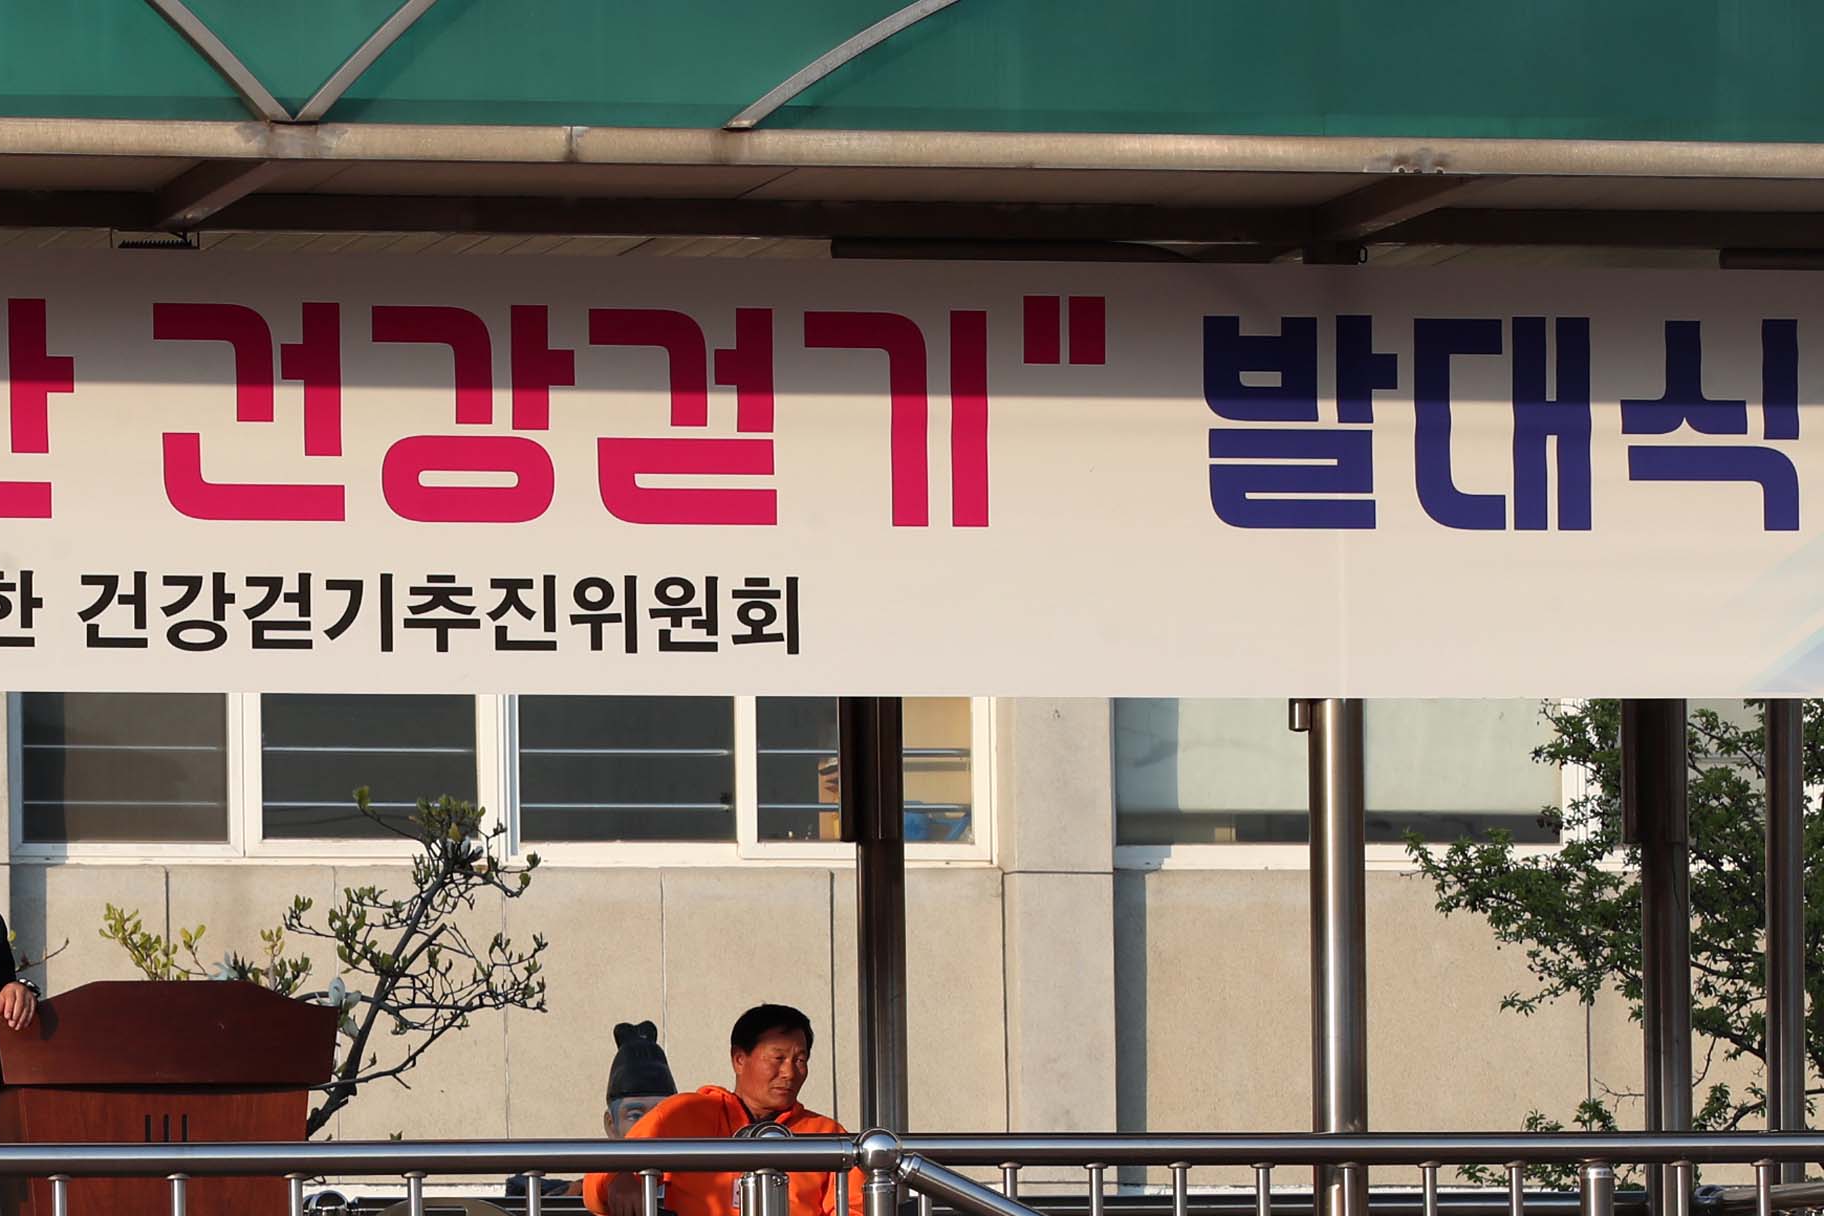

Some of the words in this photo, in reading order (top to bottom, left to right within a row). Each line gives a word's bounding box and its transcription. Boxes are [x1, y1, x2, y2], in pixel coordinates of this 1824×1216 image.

[152, 296, 1106, 528] 건강걷기"
[1203, 314, 1800, 532] 발대식
[77, 570, 800, 656] 건강걷기추진위원회
